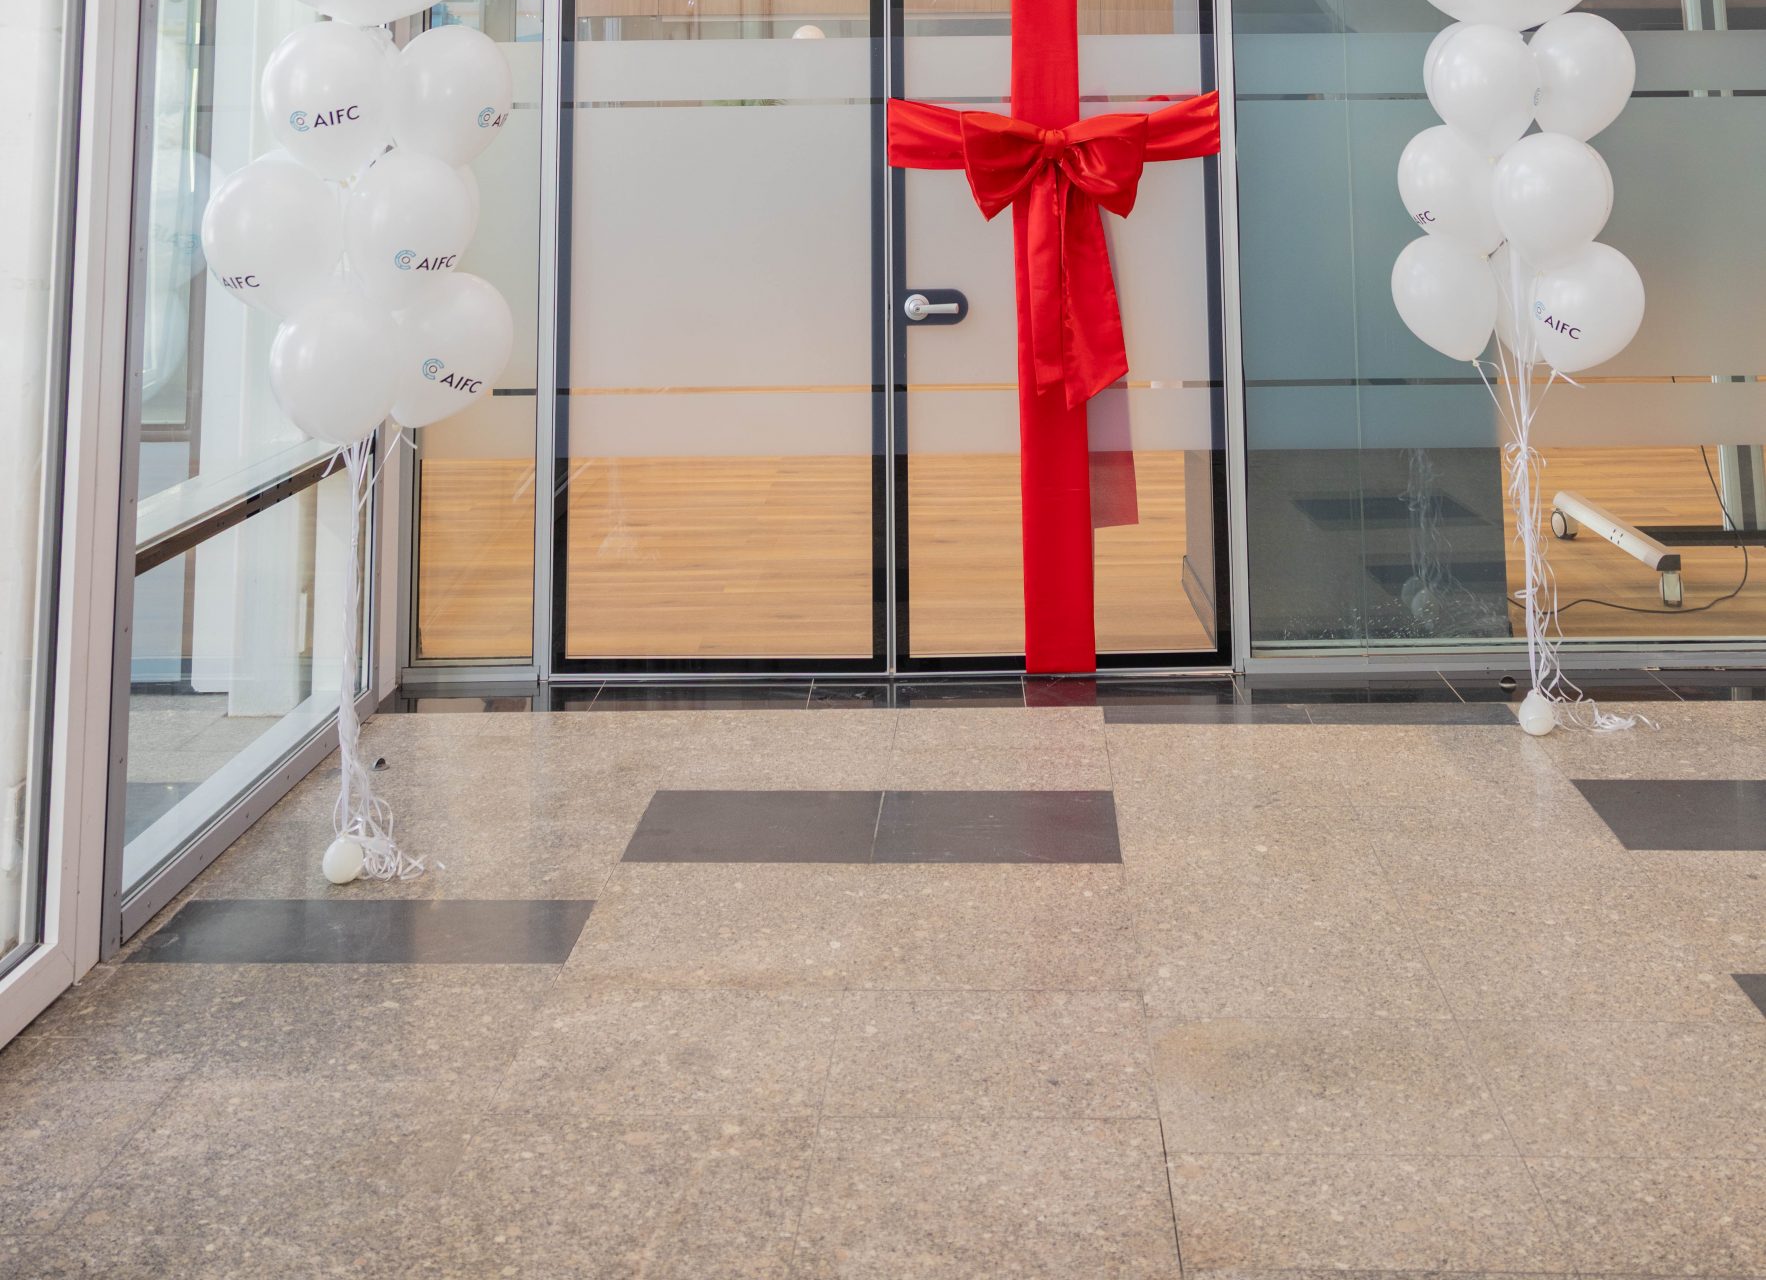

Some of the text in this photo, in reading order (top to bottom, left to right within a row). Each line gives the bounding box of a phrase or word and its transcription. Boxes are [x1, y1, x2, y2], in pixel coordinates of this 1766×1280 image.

[313, 105, 360, 128] AIFC
[415, 254, 457, 271] AIFC
[222, 275, 260, 289] AIFC
[1543, 315, 1582, 340] AIFC
[440, 372, 483, 394] AIFC
